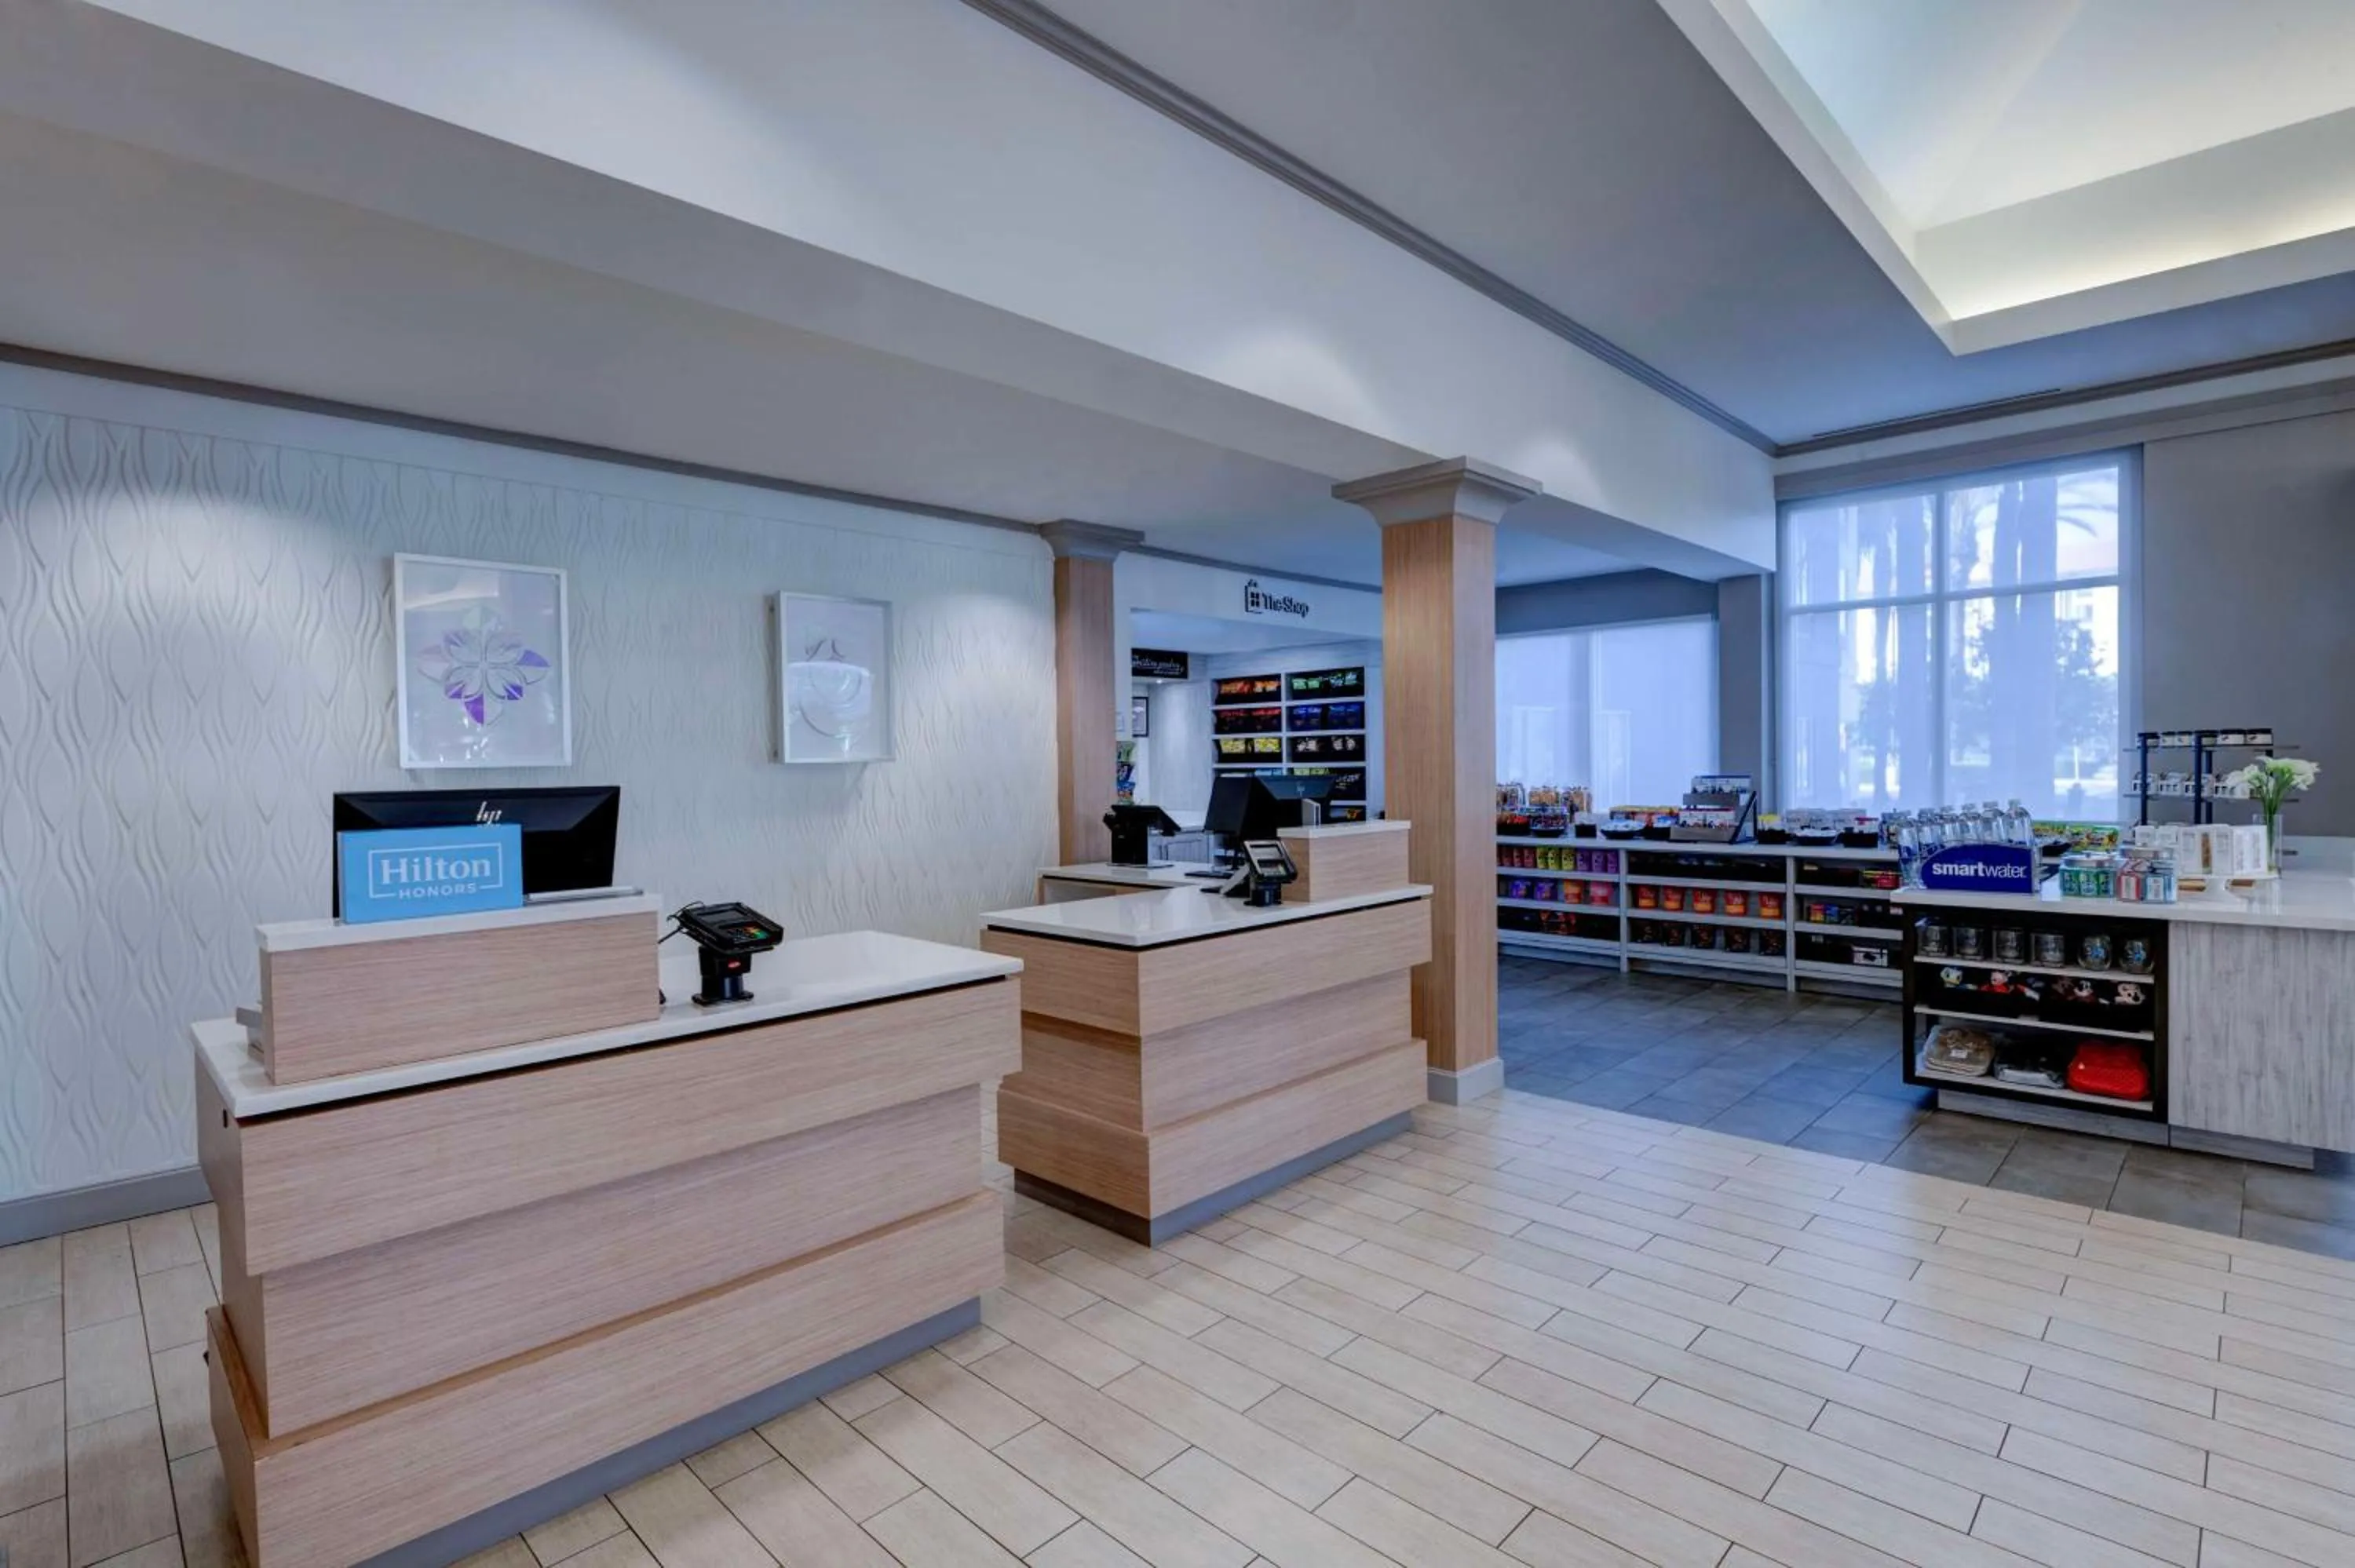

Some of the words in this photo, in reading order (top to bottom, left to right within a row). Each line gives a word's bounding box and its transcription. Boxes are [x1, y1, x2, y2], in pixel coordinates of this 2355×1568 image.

[1283, 596, 1309, 618] Shop
[380, 855, 491, 885] Hilton
[1932, 861, 2028, 878] smartwater
[398, 882, 477, 899] HONORS
